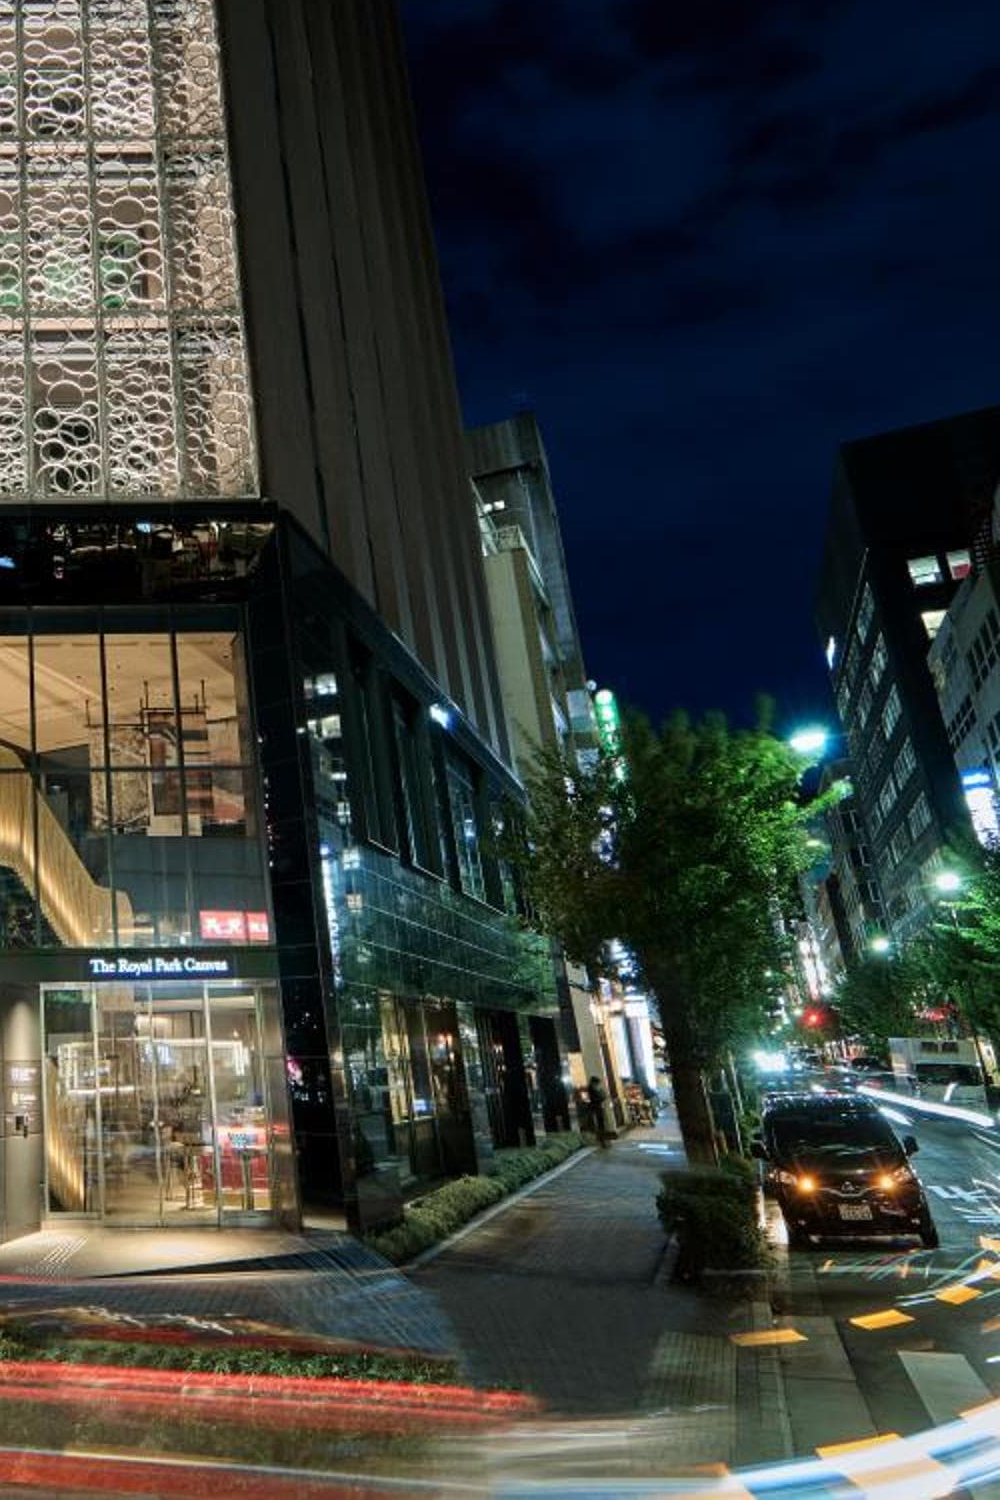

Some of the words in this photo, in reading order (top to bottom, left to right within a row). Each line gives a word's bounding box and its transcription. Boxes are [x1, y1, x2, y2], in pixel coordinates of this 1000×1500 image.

[90, 958, 116, 973] The
[118, 958, 152, 976] Royal
[155, 958, 182, 972] Park
[184, 957, 228, 972] Canvas
